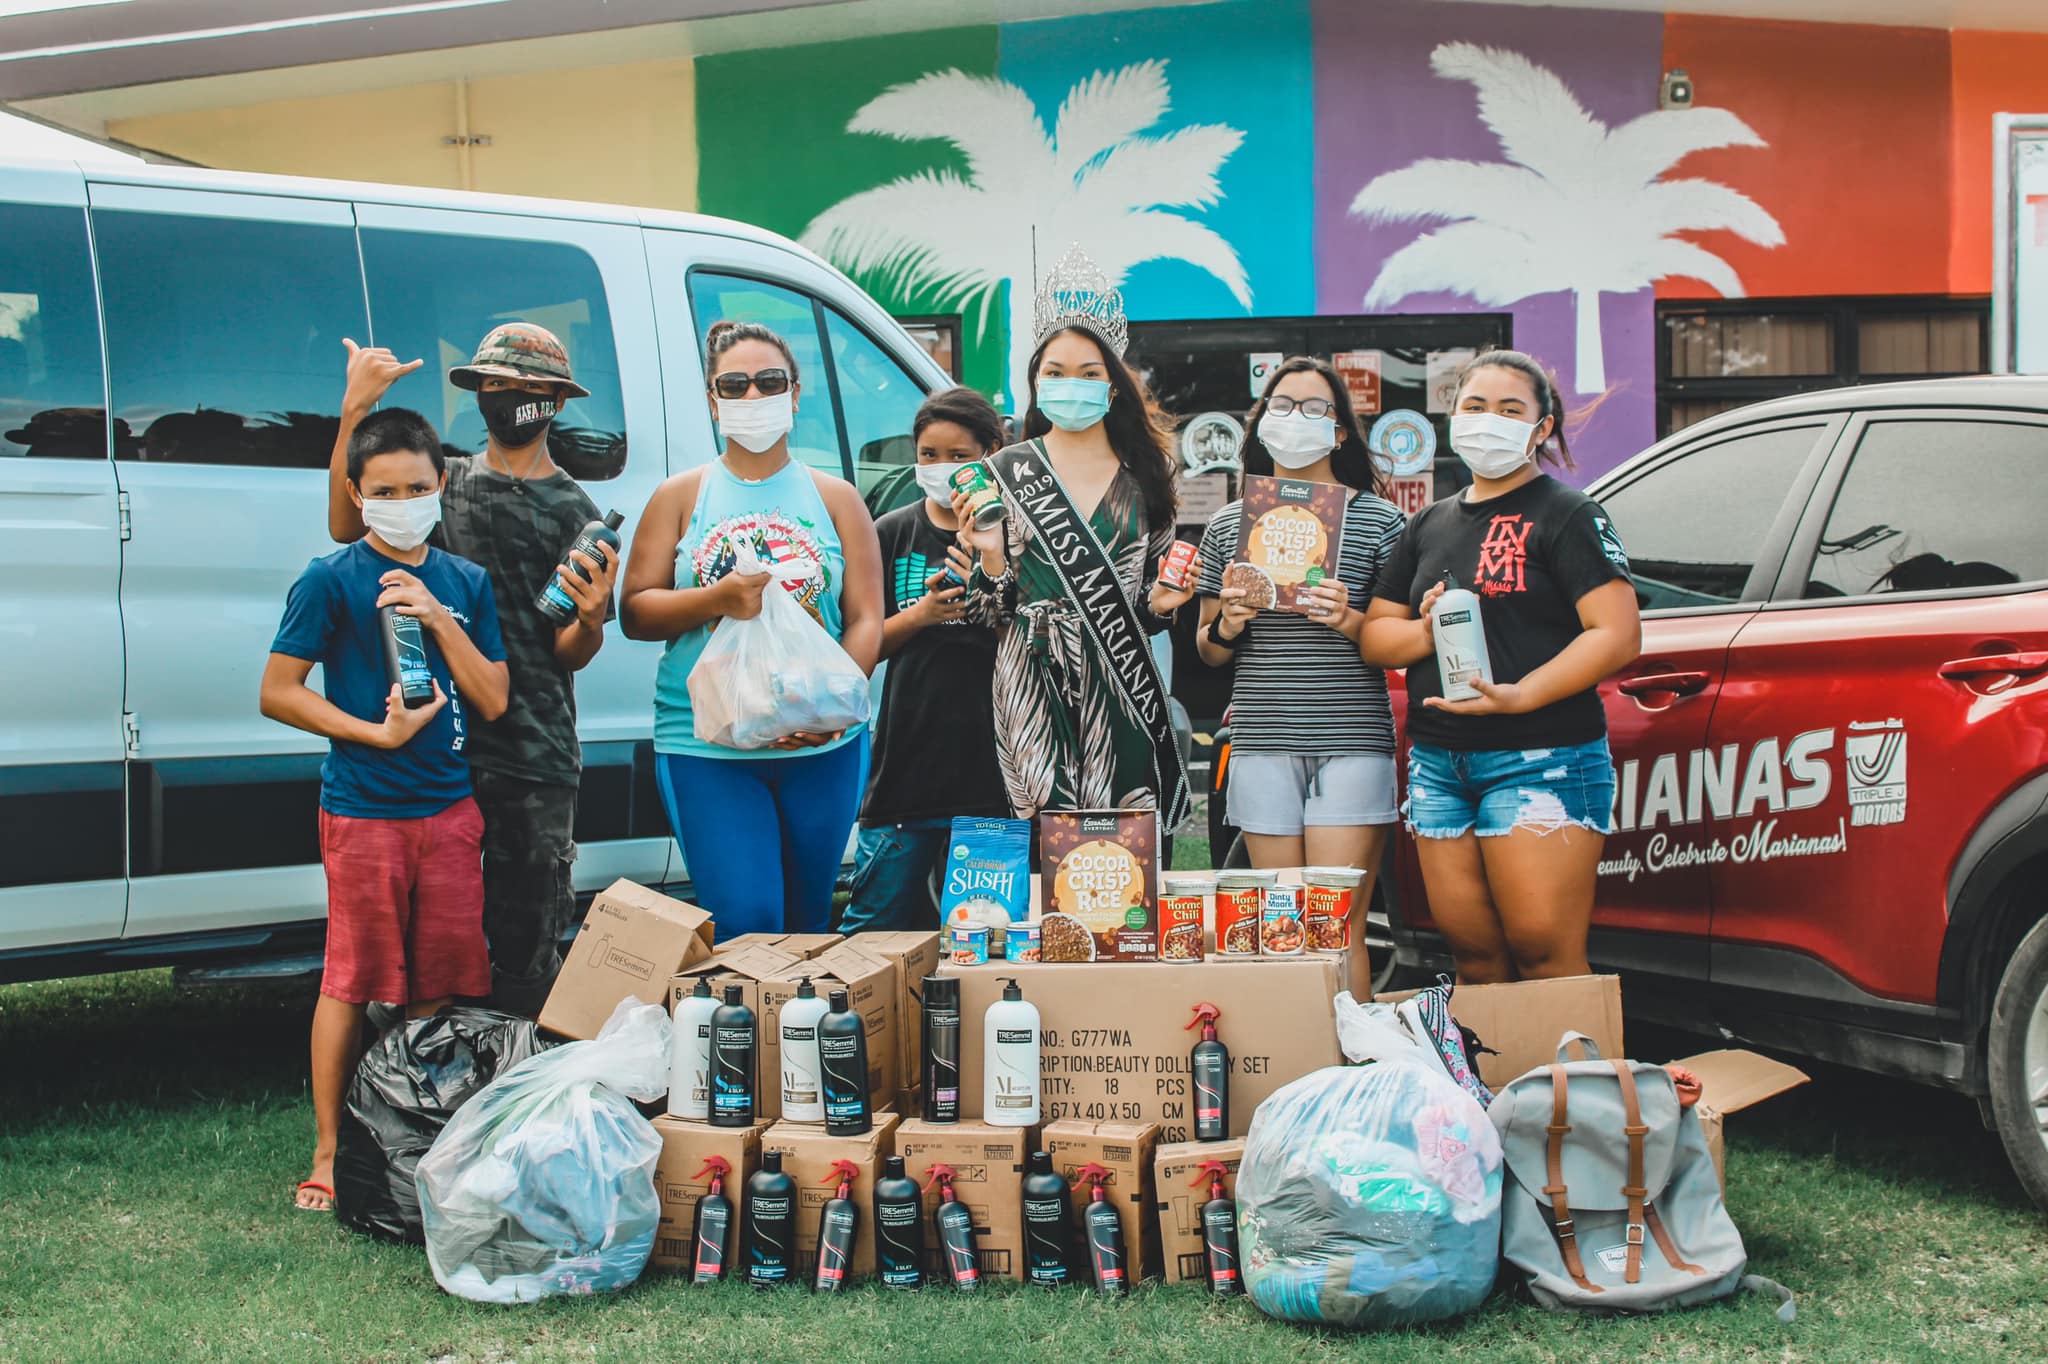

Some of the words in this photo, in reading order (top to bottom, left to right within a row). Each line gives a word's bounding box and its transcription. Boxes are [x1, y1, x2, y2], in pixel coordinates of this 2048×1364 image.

[1014, 474, 1053, 503] 2019
[1388, 481, 1426, 513] NTER
[1025, 491, 1089, 566] MISS
[1264, 514, 1317, 533] COCOA
[1261, 531, 1316, 552] CRISP
[1266, 547, 1307, 566] RICE
[1071, 565, 1159, 724] MARIANAS
[1609, 727, 1835, 833] IANAS
[1852, 788, 1893, 801] TRIPLE
[1897, 788, 1905, 798] J
[1083, 817, 1115, 826] Essential
[1851, 803, 1906, 826] MOTORS
[1647, 833, 1728, 872] Celebrate
[1730, 817, 1847, 863] Marianas!
[1068, 853, 1130, 872] COCOA
[949, 868, 1015, 902] SUSHI
[1068, 871, 1132, 891] CRISP
[1075, 890, 1123, 912] RICE
[1232, 895, 1258, 904] Horm
[1269, 893, 1291, 902] Dinty
[1310, 901, 1334, 911] Chili
[1173, 910, 1199, 920] Chili
[1238, 904, 1258, 914] Chil
[675, 987, 682, 1000] 6
[764, 992, 771, 1005] 6
[1071, 1029, 1133, 1048] G777WA
[1243, 1057, 1270, 1074] SET
[1043, 1078, 1075, 1095] TITY:
[1104, 1078, 1119, 1095] 18
[1156, 1079, 1185, 1096] PCS
[1051, 1102, 1068, 1118] 67
[1073, 1103, 1081, 1118] X
[1086, 1103, 1105, 1120] 40
[1110, 1103, 1118, 1119] X
[1122, 1103, 1141, 1120] 50
[1162, 1102, 1184, 1119] CM
[905, 1144, 912, 1157] 6
[1049, 1141, 1056, 1153] 6
[1164, 1167, 1172, 1179] 6
